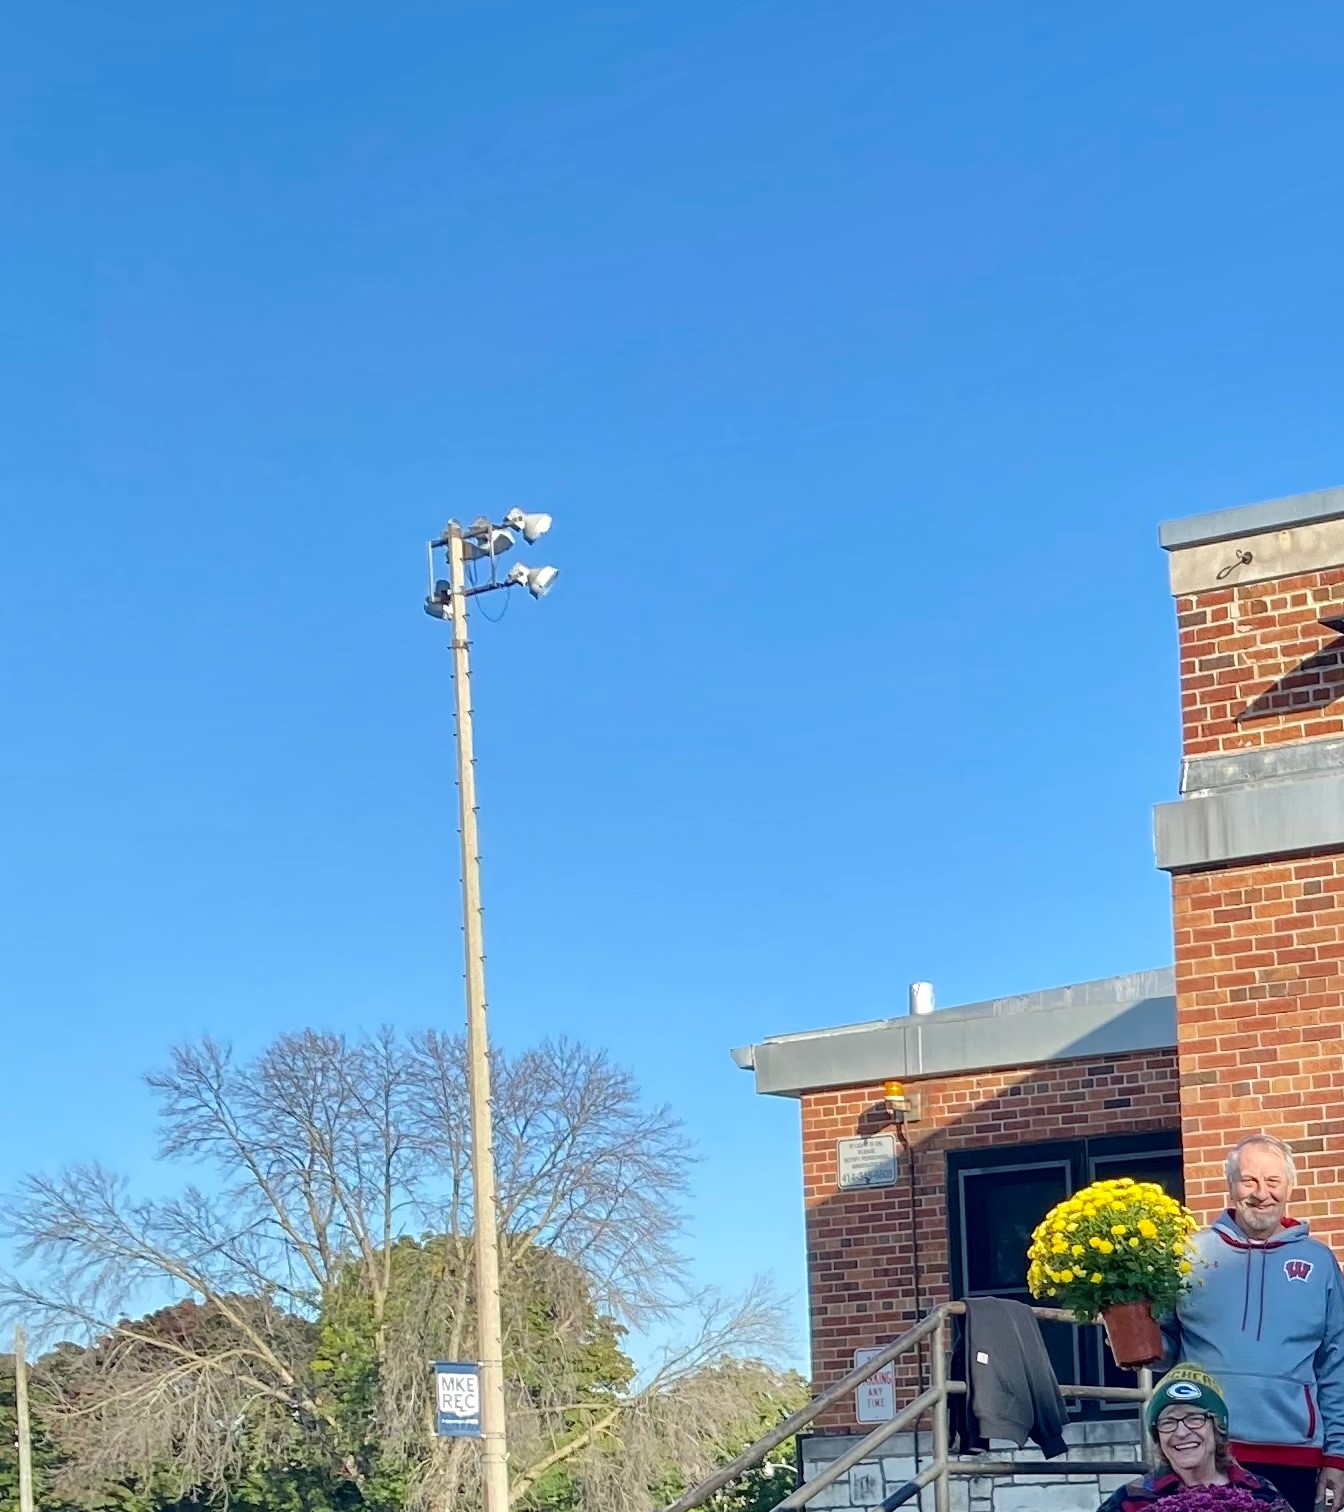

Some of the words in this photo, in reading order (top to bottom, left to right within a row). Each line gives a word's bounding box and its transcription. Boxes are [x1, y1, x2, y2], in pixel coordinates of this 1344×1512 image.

[1284, 1259, 1313, 1282] W
[442, 1377, 474, 1392] MKE
[868, 1388, 882, 1396] ANY
[442, 1394, 475, 1409] REC
[867, 1398, 885, 1408] TIME
